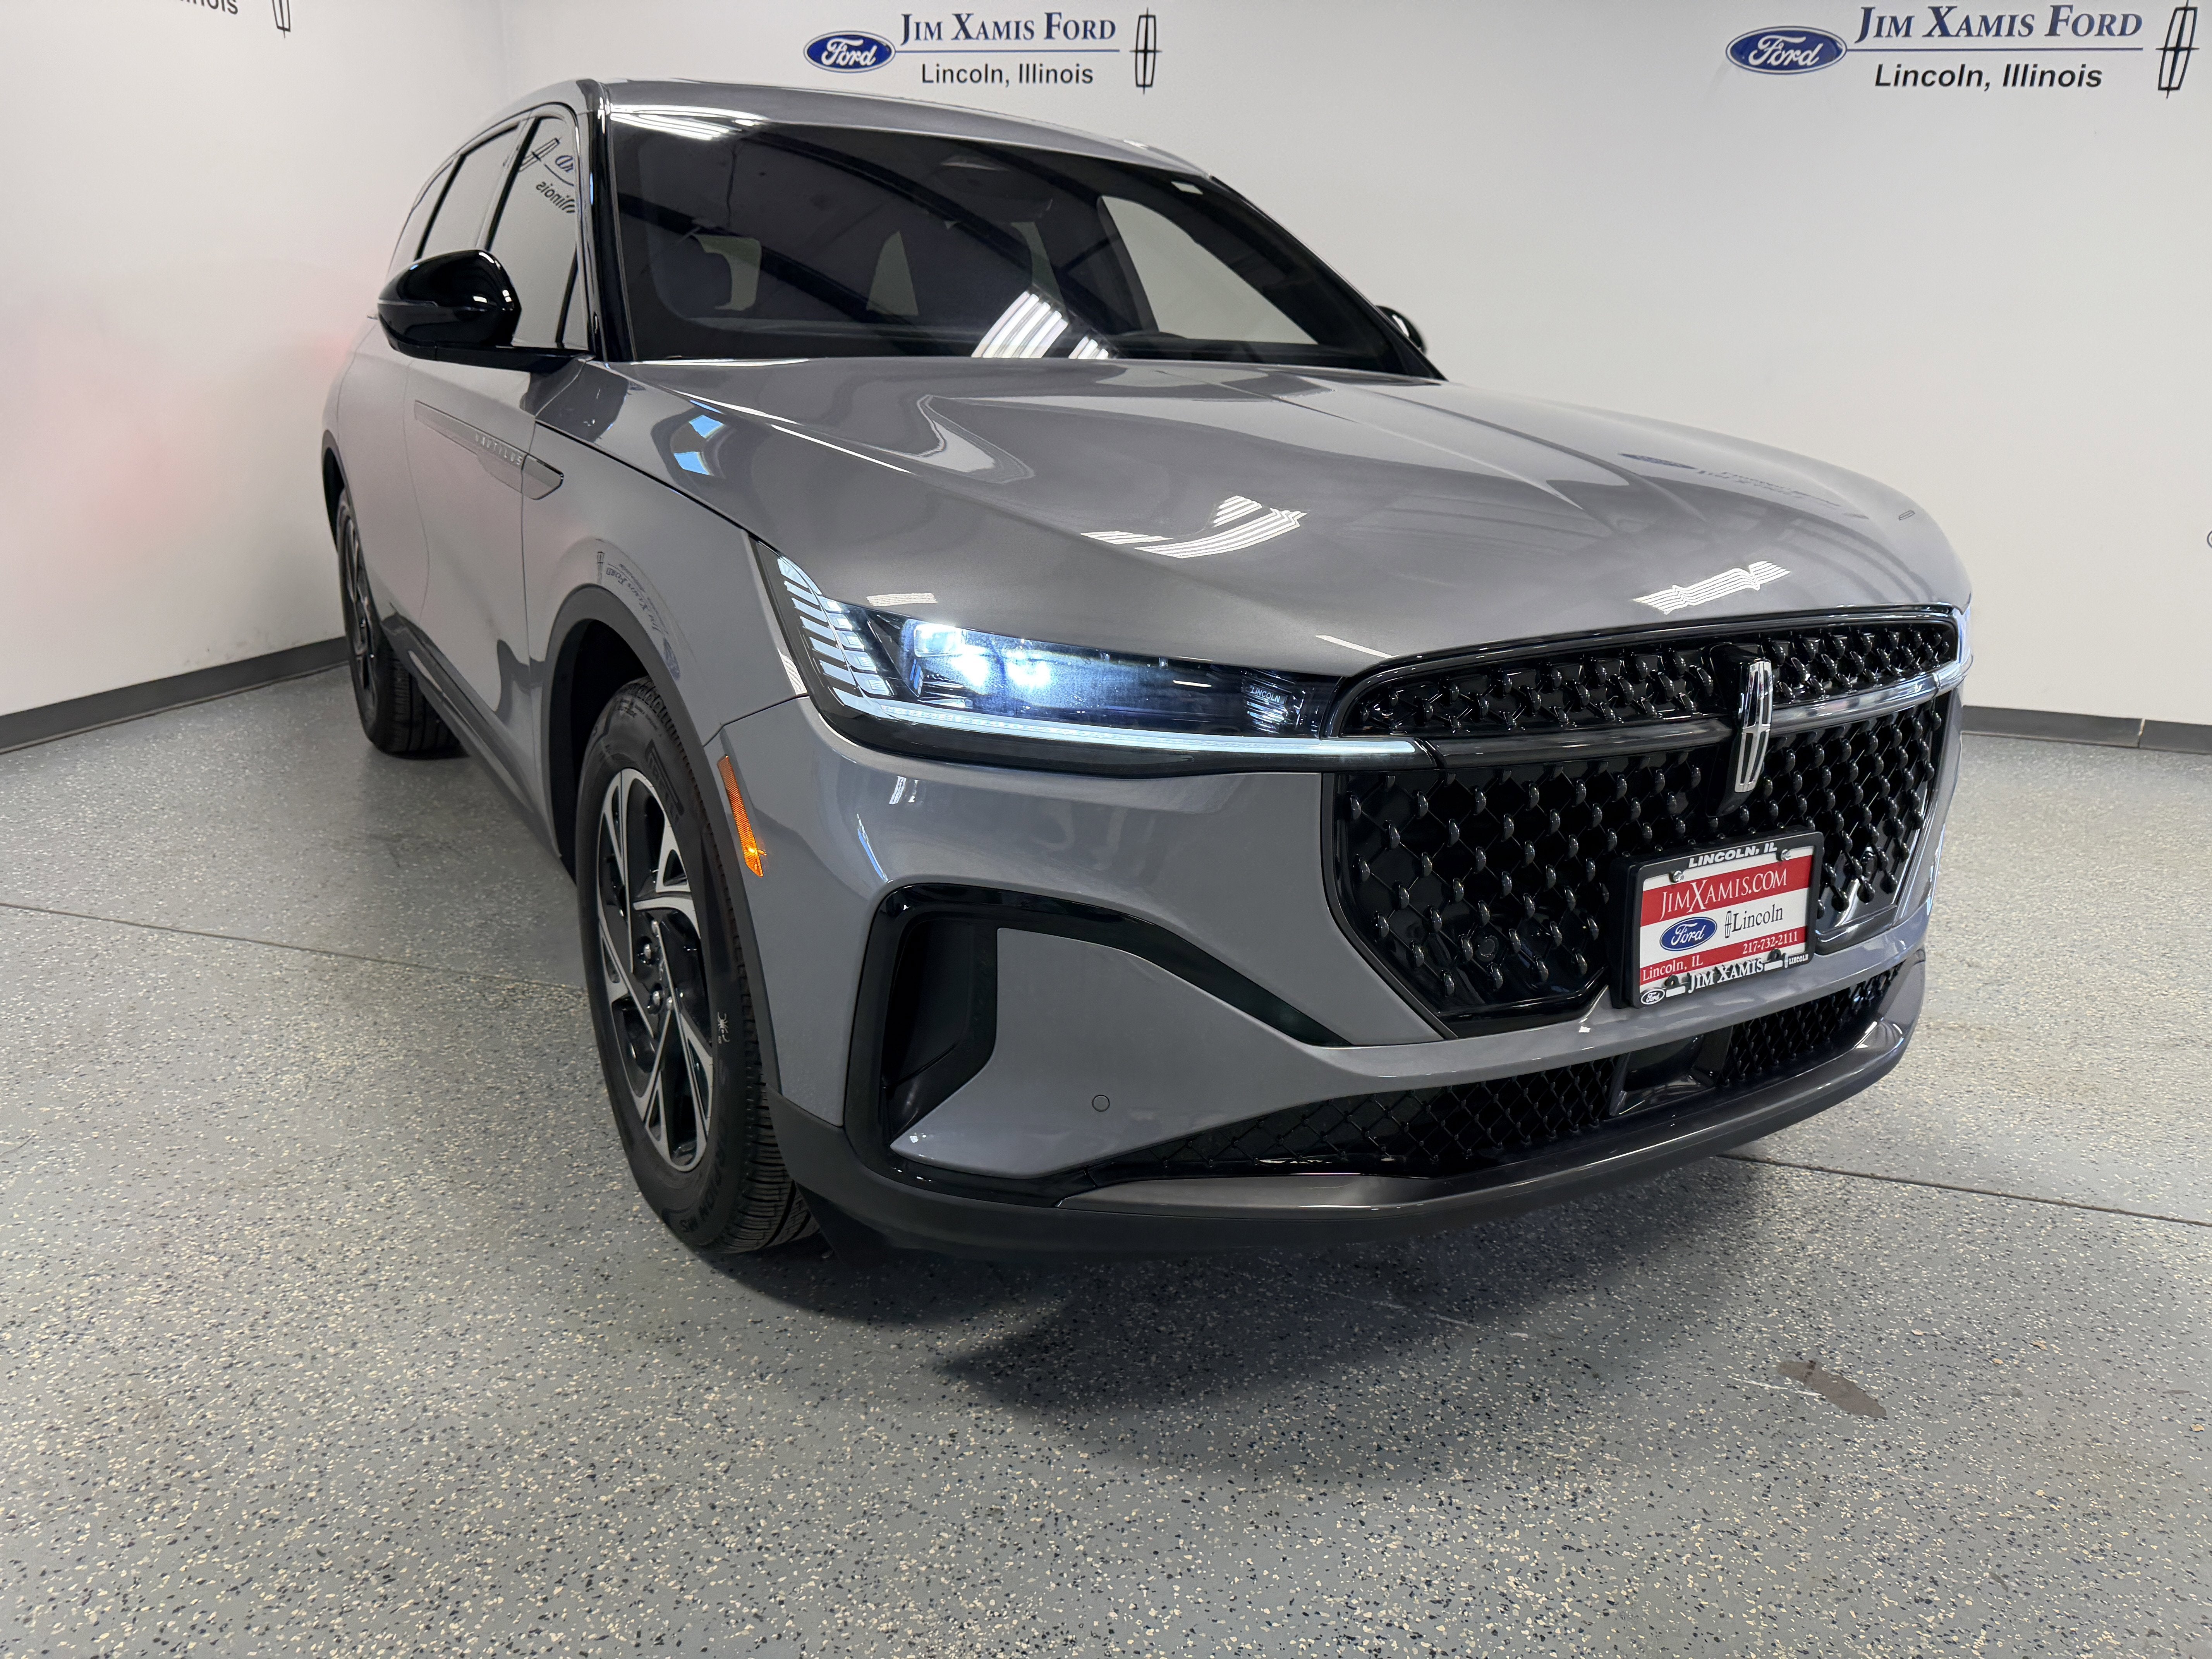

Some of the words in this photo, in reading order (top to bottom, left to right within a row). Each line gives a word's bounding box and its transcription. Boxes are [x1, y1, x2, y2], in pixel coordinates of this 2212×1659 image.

[901, 14, 942, 46] JIM
[951, 13, 1034, 40] XAMIS
[1044, 12, 1116, 40] FORD
[1854, 7, 1913, 43] JIM
[1926, 5, 2035, 38] XAMIS
[2044, 4, 2143, 37] FORD
[821, 38, 877, 66] Ford
[1748, 35, 1823, 65] Ford
[922, 64, 1009, 88] Lincoln,
[1019, 63, 1093, 84] Illinois
[1875, 64, 1990, 91] Lincoln,
[2002, 64, 2102, 88] Illinois
[1250, 687, 1281, 703] LINCOLN
[1688, 845, 1760, 868] LINCOLN,
[1763, 842, 1778, 853] IL
[1659, 868, 1787, 921] JIMXAMIS.COM
[1731, 903, 1783, 932] Lincoln
[1671, 922, 1706, 946] Ford
[1742, 931, 1798, 955] 217-732-2111
[1642, 959, 1687, 981] Lincoln,
[1692, 955, 1703, 967] IL
[1789, 953, 1808, 965] LINCOLN
[1688, 970, 1715, 994] JIM
[1717, 959, 1764, 983] XAMIS
[1646, 992, 1660, 1003] Ford
